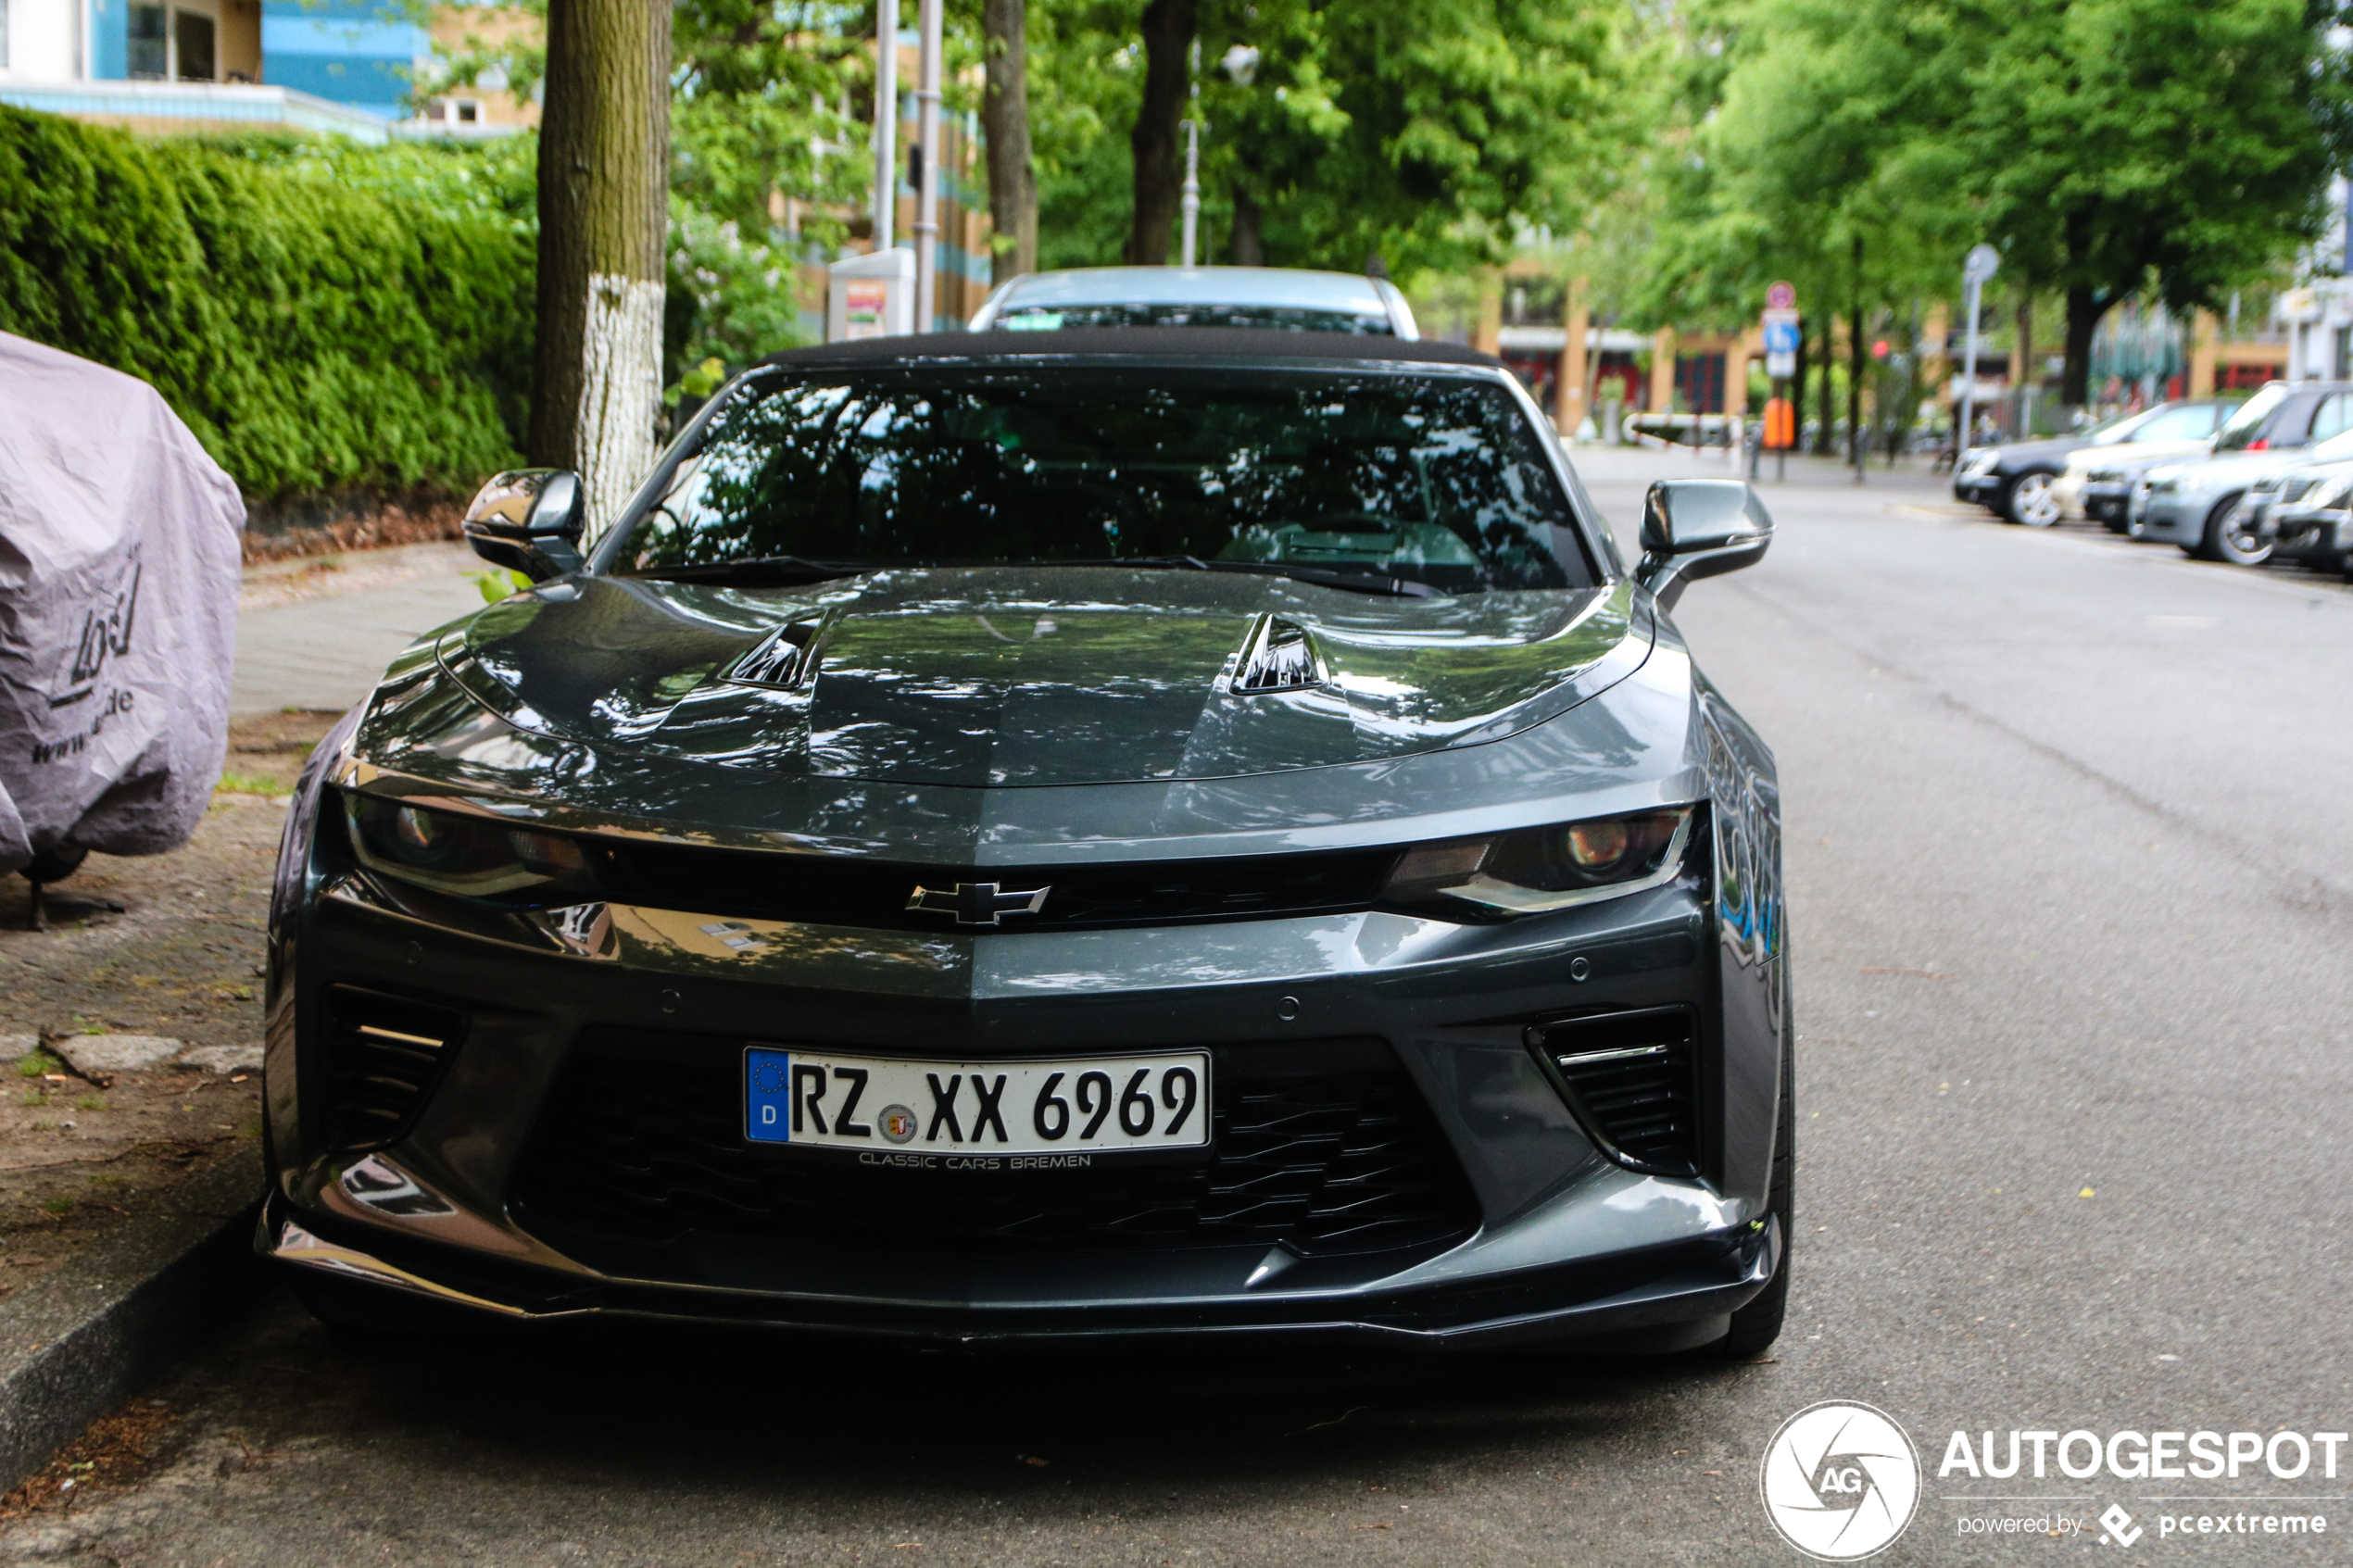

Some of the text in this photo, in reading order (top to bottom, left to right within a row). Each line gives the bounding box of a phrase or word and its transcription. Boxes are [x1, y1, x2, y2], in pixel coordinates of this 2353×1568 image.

[791, 1062, 873, 1138] RZ
[925, 1073, 1010, 1144] XX
[1033, 1066, 1199, 1141] 6969
[761, 1105, 777, 1125] D
[858, 1151, 1092, 1171] CLASSIC CARS BREMEN
